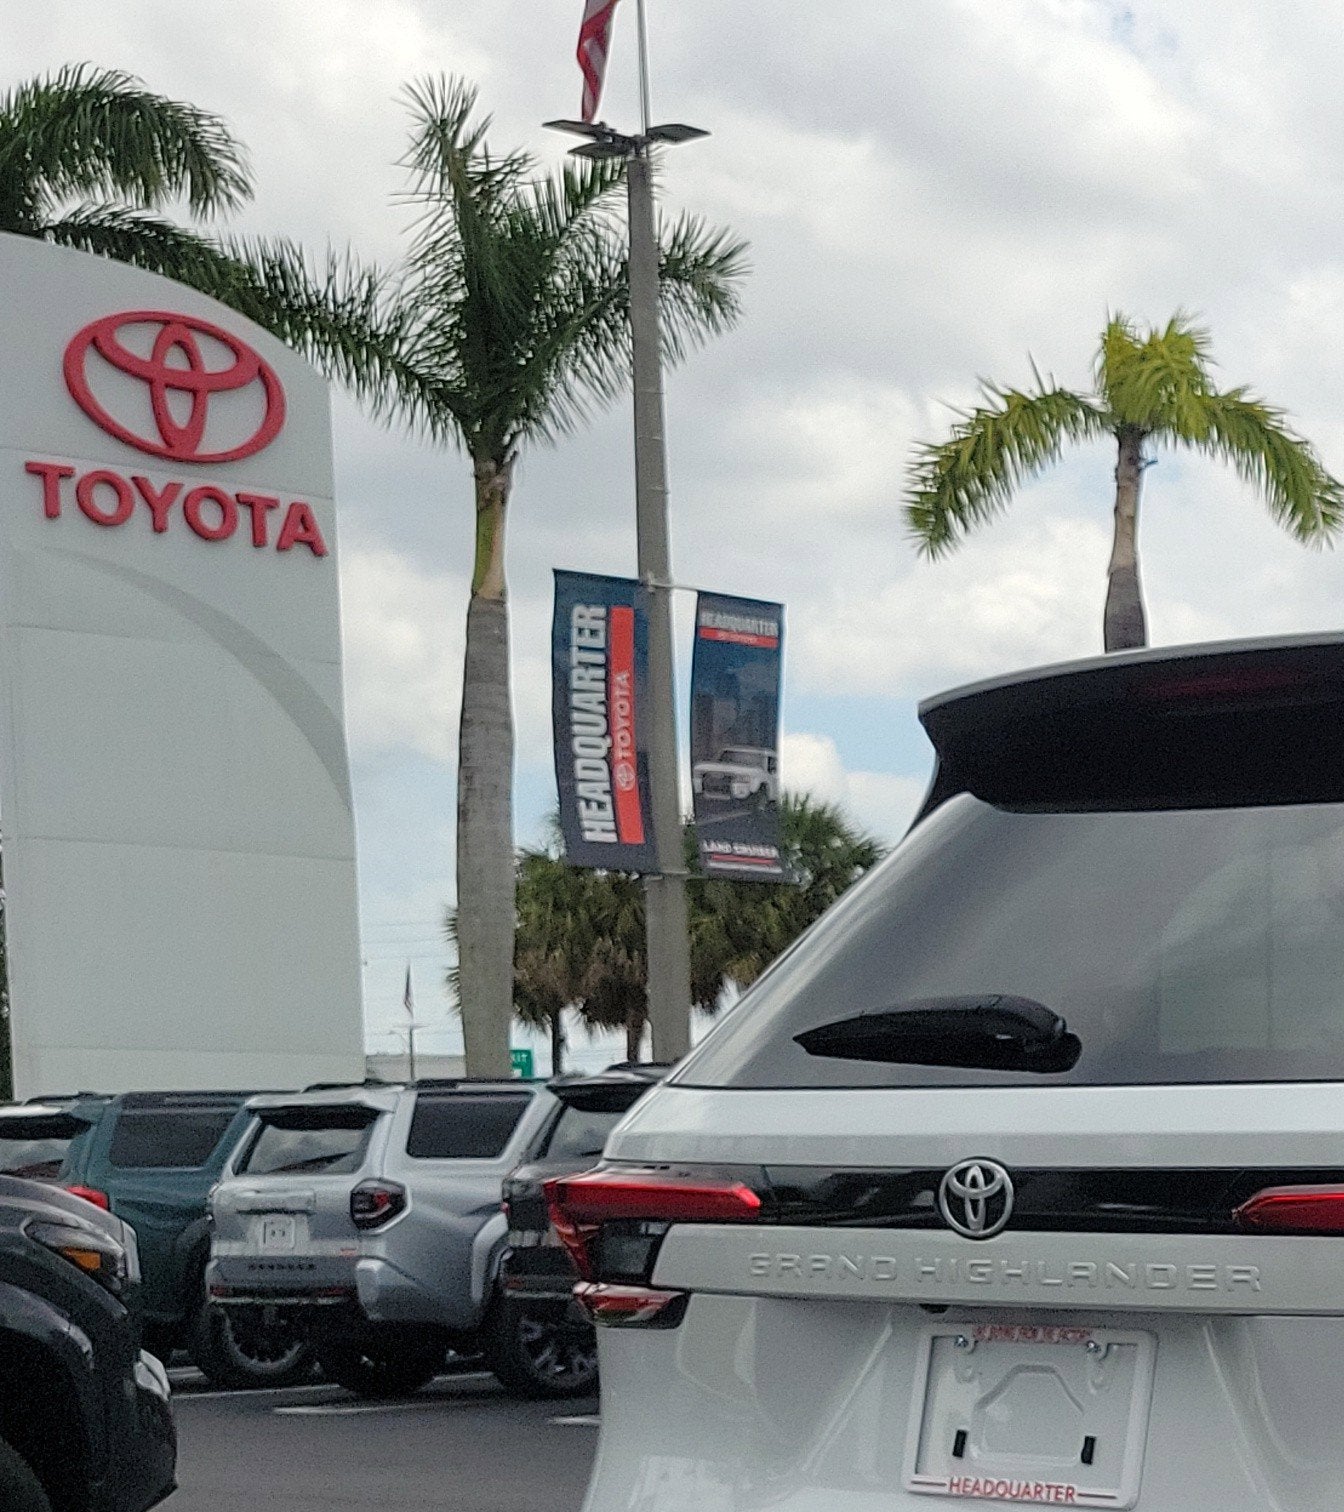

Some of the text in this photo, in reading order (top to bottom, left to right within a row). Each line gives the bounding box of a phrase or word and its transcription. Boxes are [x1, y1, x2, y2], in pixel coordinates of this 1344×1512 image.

[25, 461, 328, 557] TOYOTA
[571, 604, 618, 843] HEADQUARTER
[614, 671, 631, 760] TOYOTA
[748, 1253, 1261, 1292] GRAND HIGHLANDER
[949, 1477, 1076, 1502] HEADQUARTER
